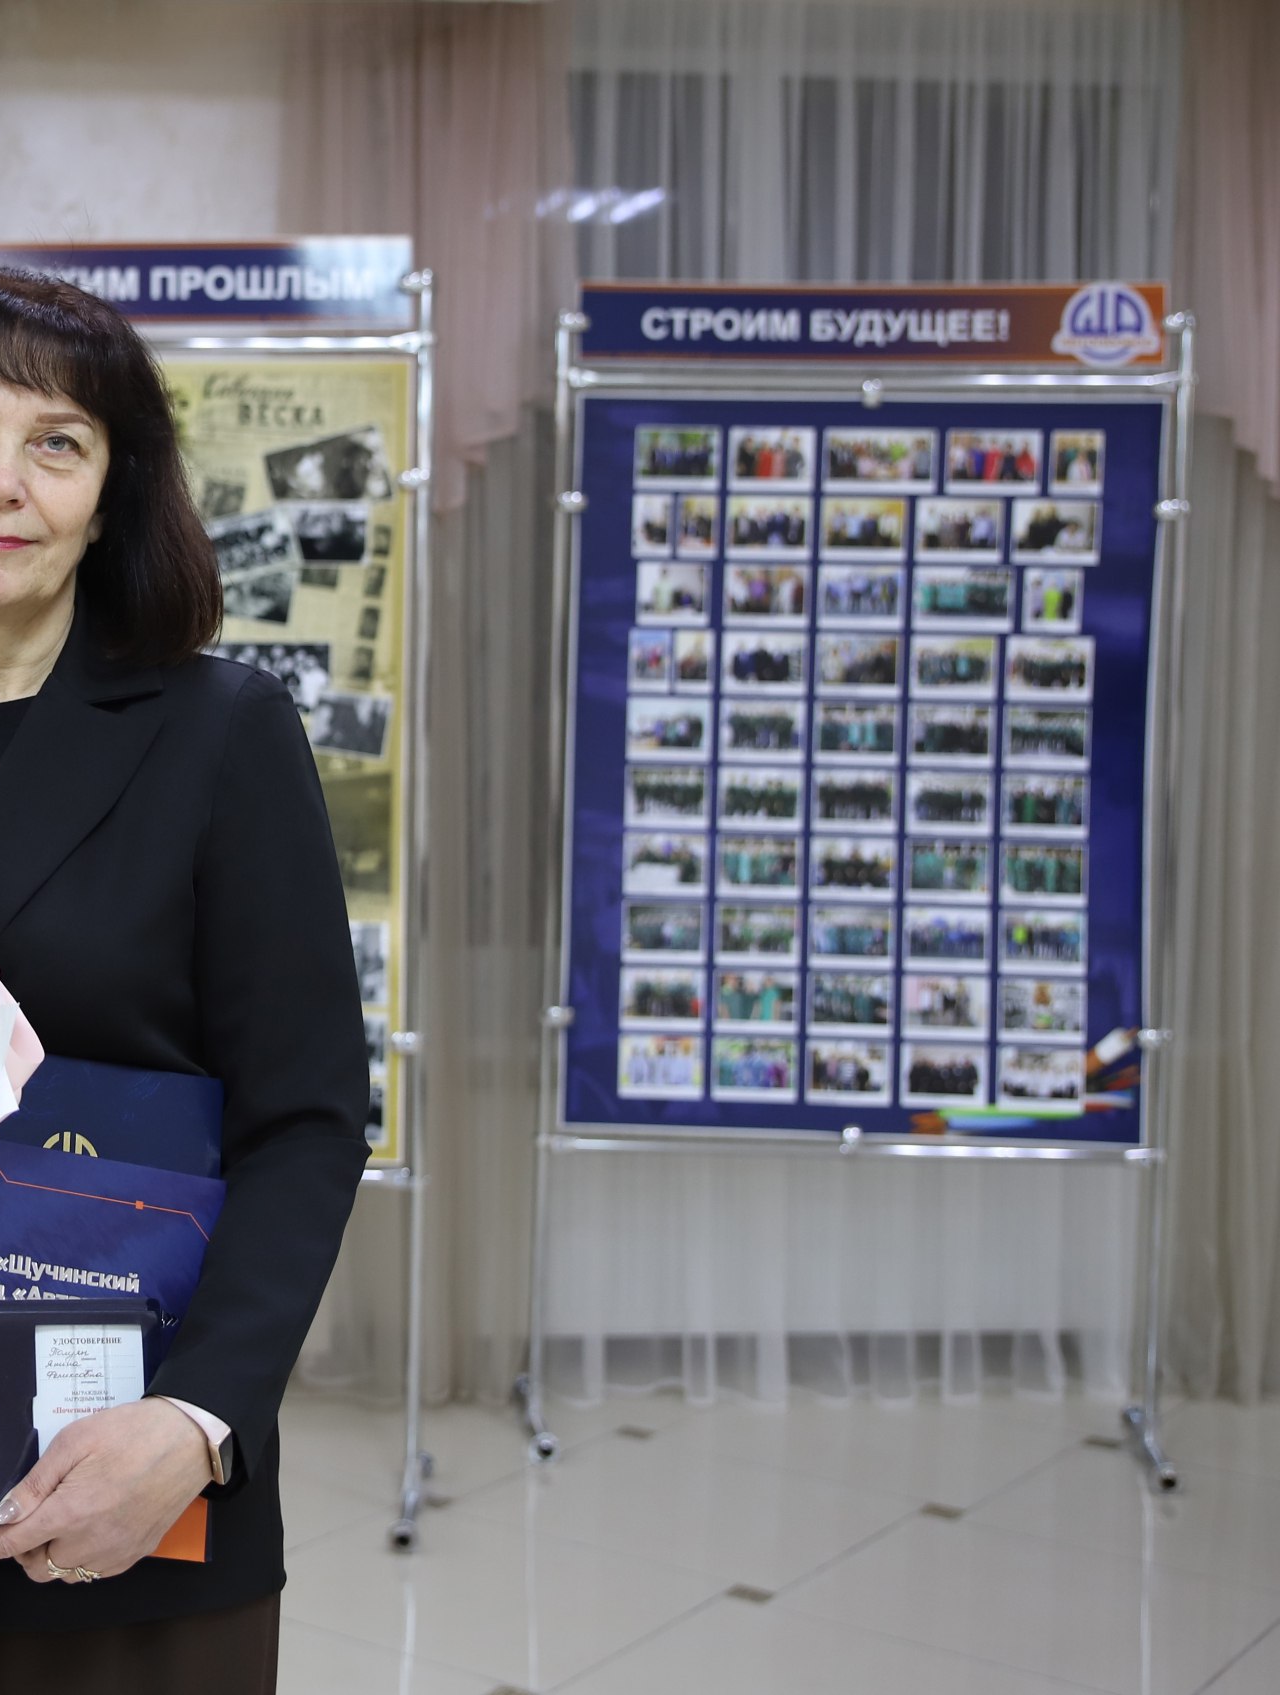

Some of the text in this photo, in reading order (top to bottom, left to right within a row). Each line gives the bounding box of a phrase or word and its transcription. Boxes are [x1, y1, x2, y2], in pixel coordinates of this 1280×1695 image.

[149, 264, 375, 301] ПРОШЛЫМ
[641, 308, 1010, 347] СТРОИМ БУДУЩЕЕ!
[52, 1337, 122, 1345] УДОСТОВЕРЕНИЕ
